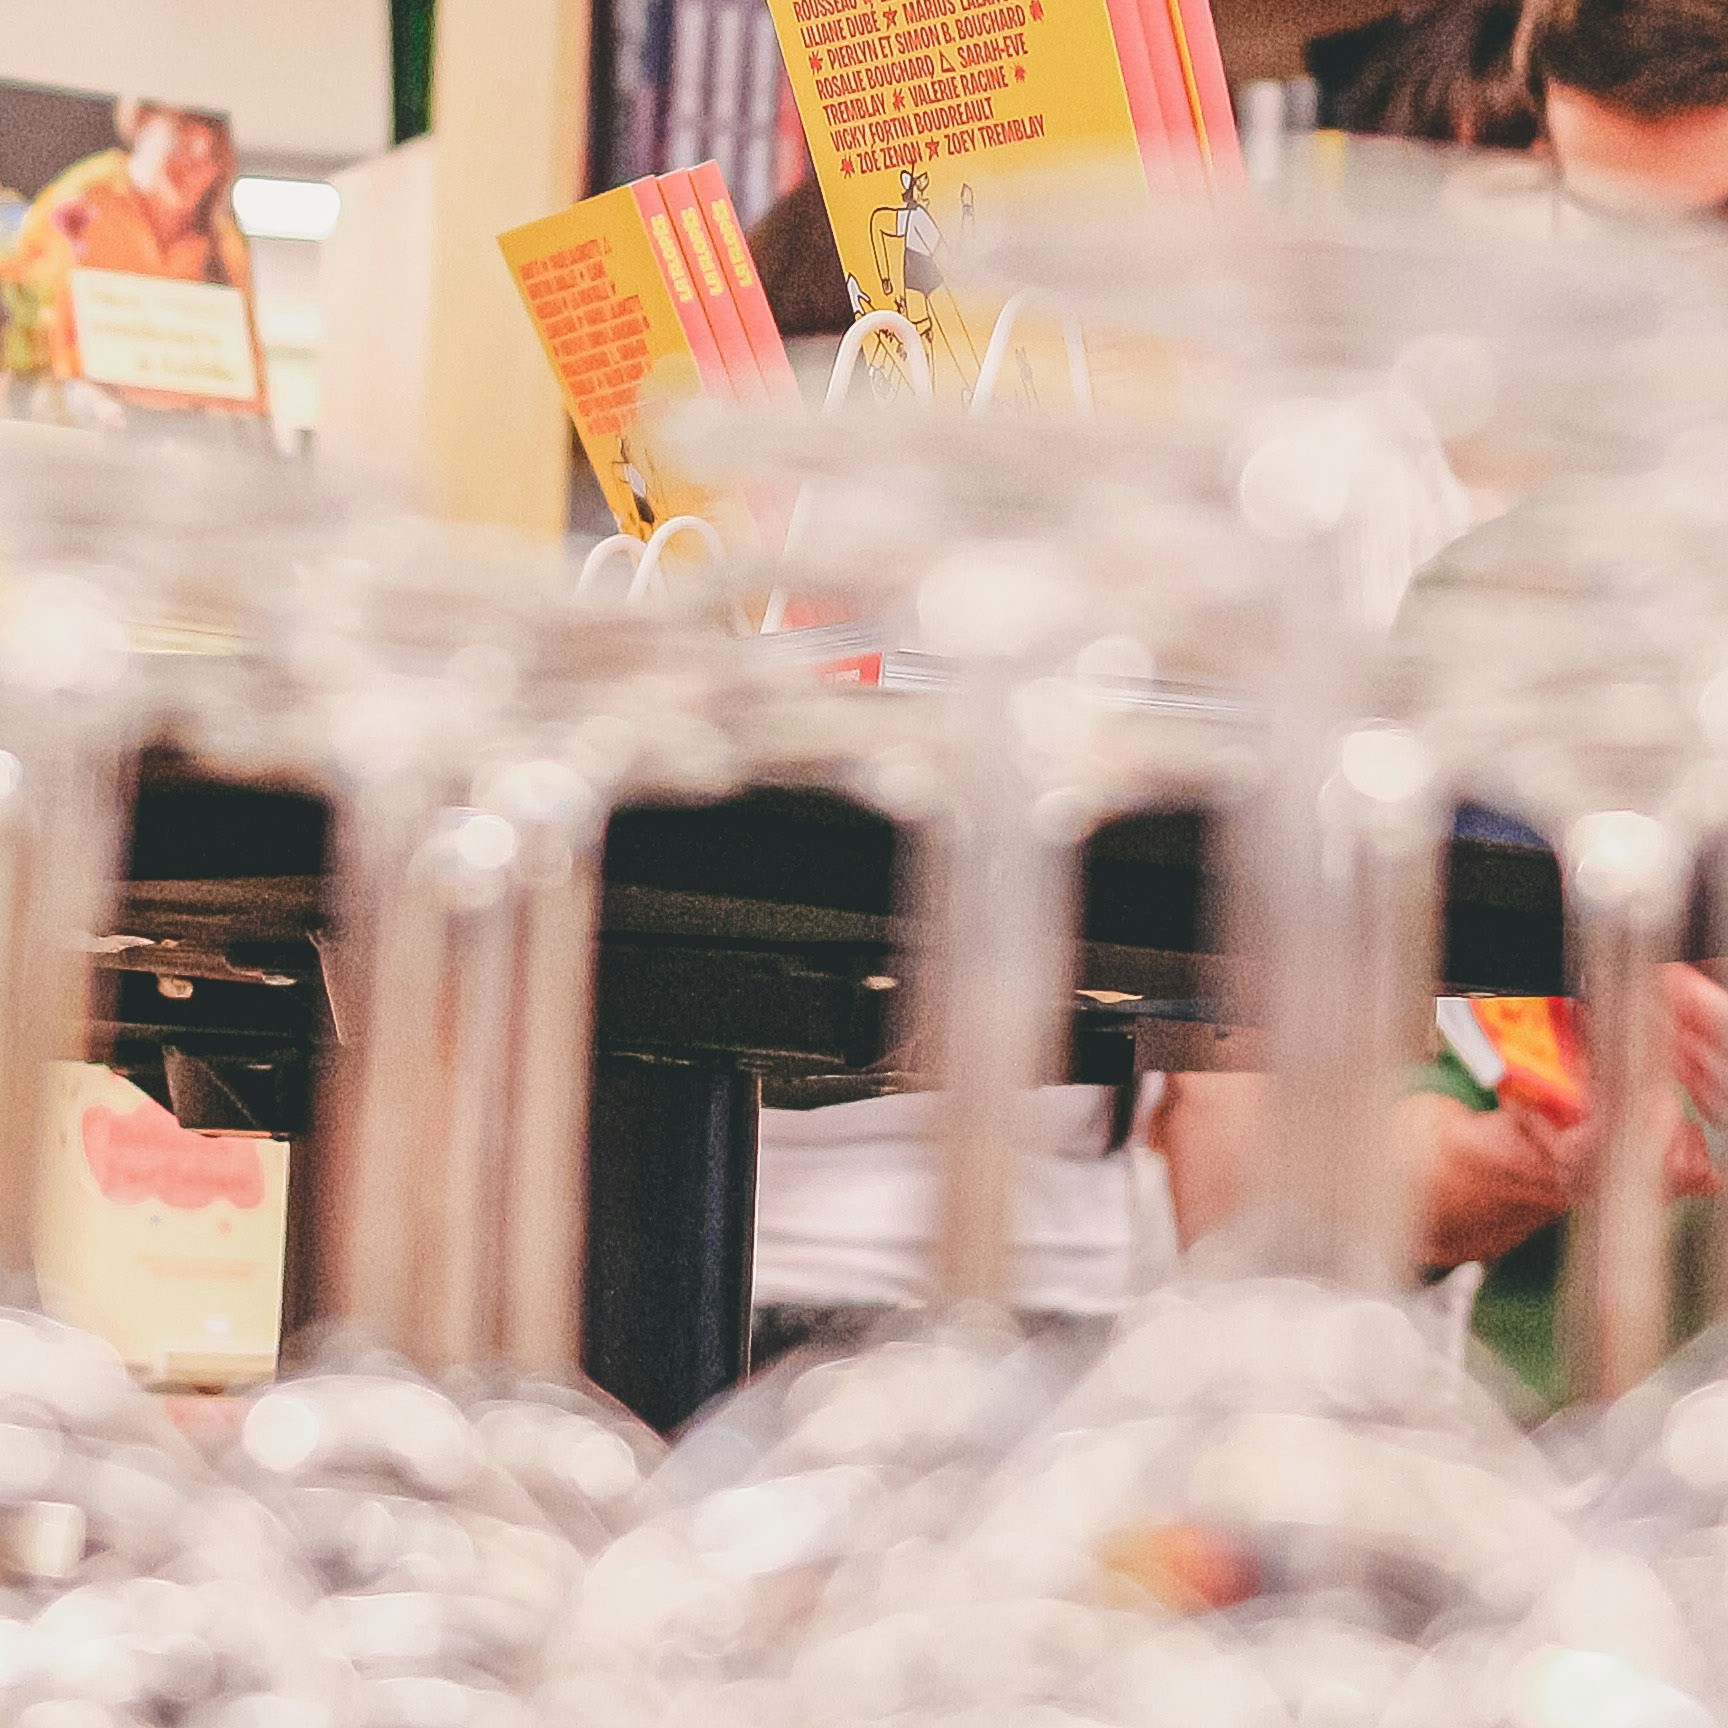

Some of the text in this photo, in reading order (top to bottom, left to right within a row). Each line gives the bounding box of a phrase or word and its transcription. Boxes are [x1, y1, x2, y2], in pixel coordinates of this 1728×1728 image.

[800, 18, 847, 48] LILIANE
[847, 5, 881, 37] DUBÉ
[826, 38, 878, 70] PIERLYN
[878, 35, 895, 60] ET
[894, 26, 940, 55] SIMON
[956, 4, 1026, 40] BOUCHARD
[816, 70, 866, 100] ROSALIE
[867, 55, 935, 88] BOUCHARD
[823, 93, 887, 126] TREMBLAY
[960, 66, 1009, 96] RACINE
[830, 97, 994, 152] VICKY FORTIN BOUDREAULT
[856, 139, 882, 174] ZOÉ
[944, 130, 979, 156] ZOEY
[977, 114, 1045, 149] TREMBLAY
